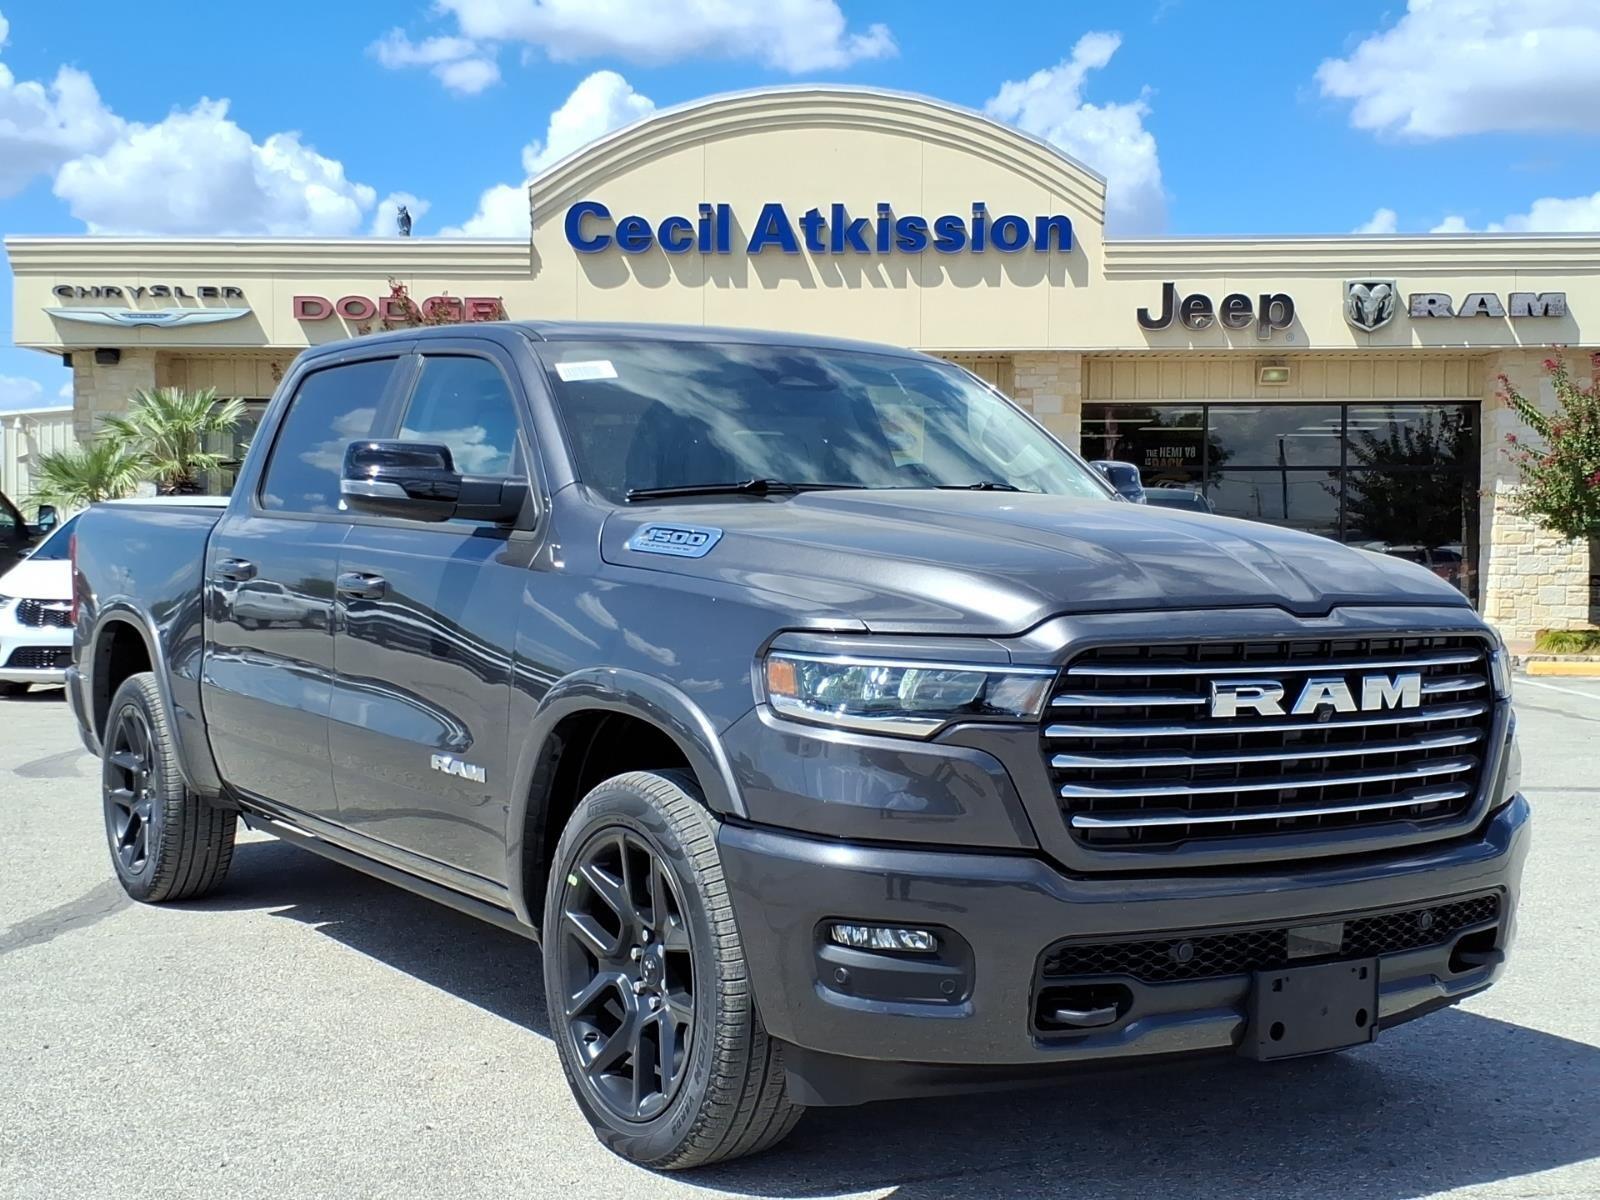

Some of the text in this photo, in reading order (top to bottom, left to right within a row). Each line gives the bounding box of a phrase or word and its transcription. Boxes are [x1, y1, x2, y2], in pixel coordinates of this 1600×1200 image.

[563, 200, 1074, 254] Cecil Atkission
[53, 284, 244, 299] CHRYSLER
[1408, 292, 1567, 318] RAM
[1137, 282, 1296, 340] Jeep
[1145, 446, 1196, 458] THE HEMI V8
[646, 528, 708, 547] 1500
[1210, 672, 1422, 718] RAM
[431, 753, 488, 784] RAM
